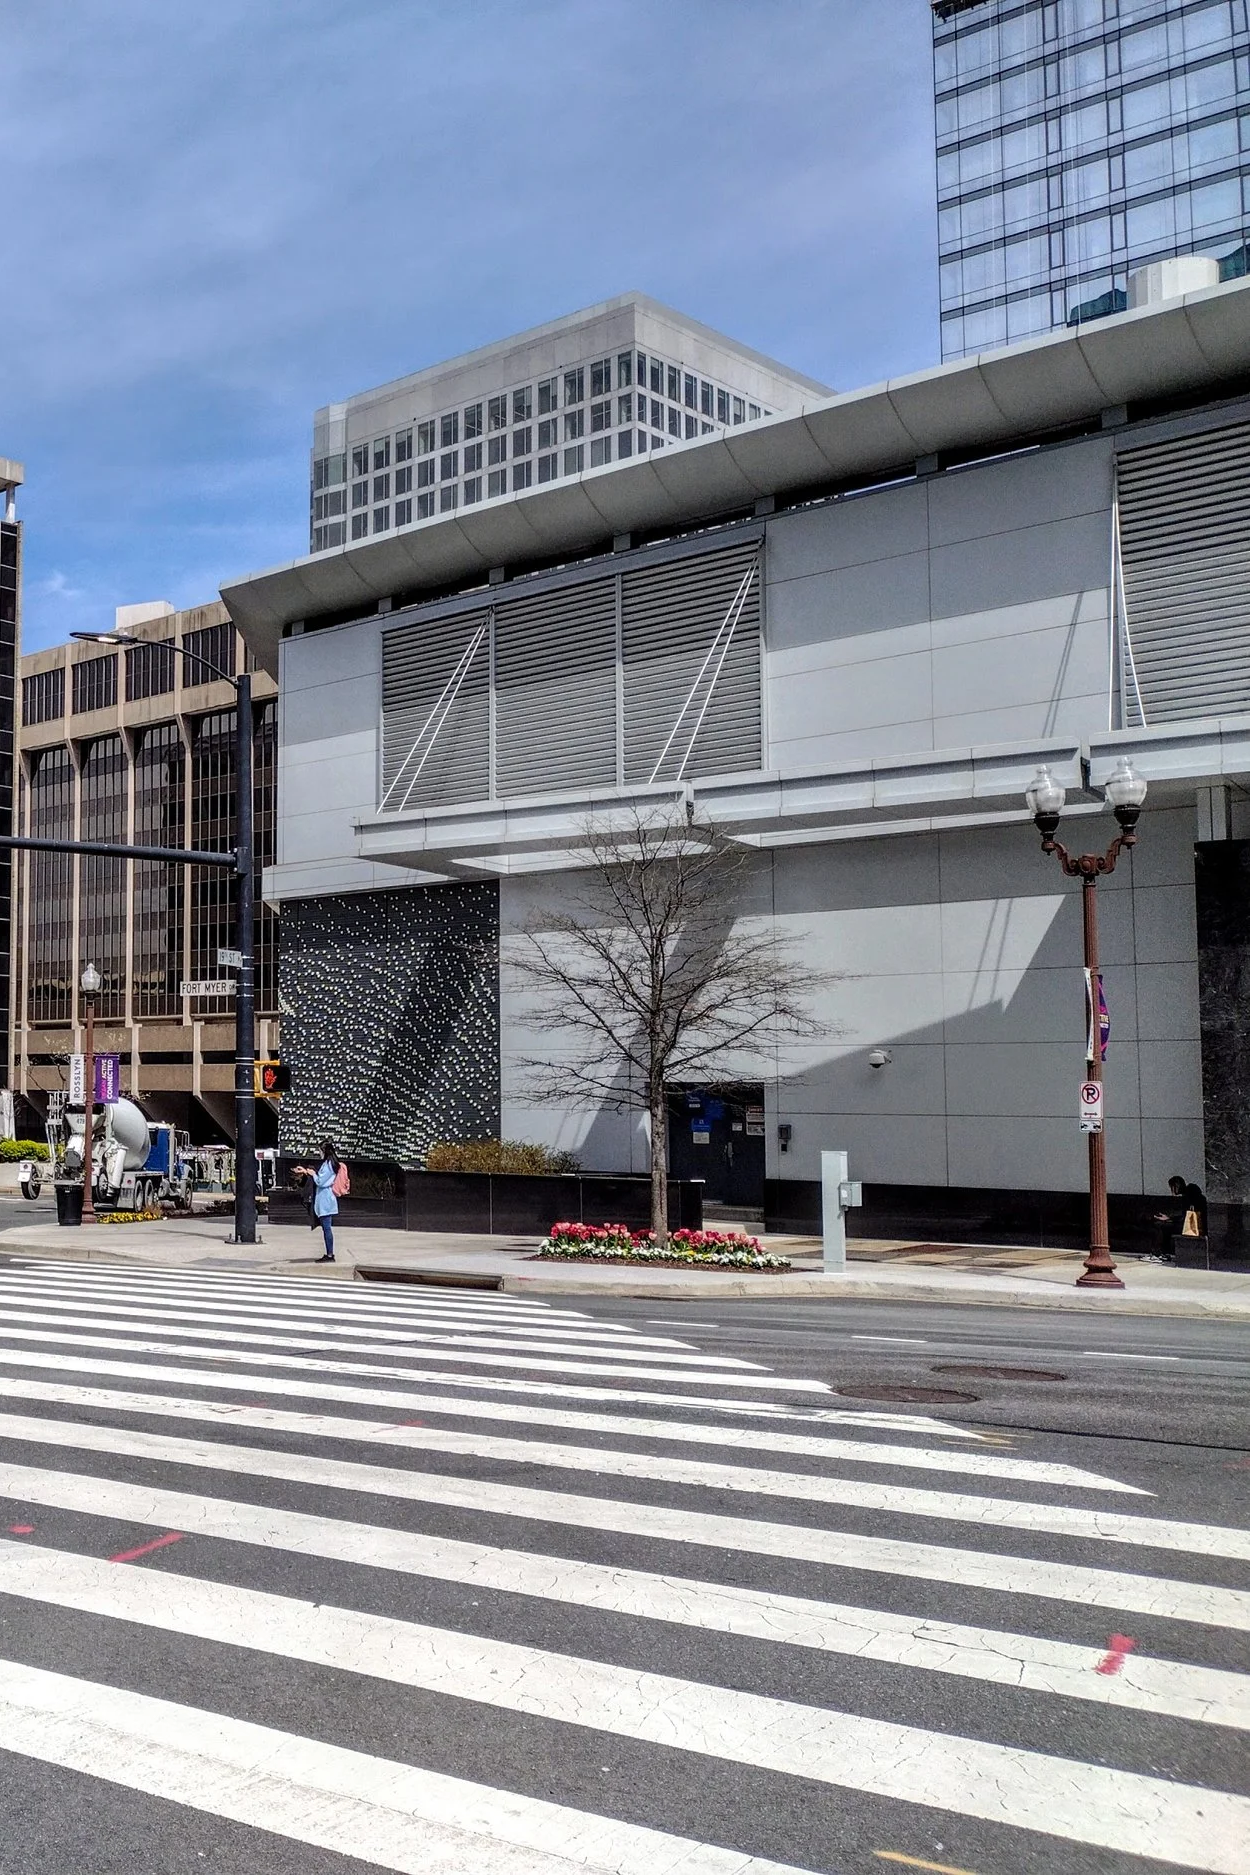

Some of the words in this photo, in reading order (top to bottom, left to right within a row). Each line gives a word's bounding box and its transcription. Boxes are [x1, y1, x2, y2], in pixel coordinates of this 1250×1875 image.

[181, 983, 202, 994] FORT
[204, 982, 227, 993] MYER
[73, 1059, 81, 1099] ROSSLYN
